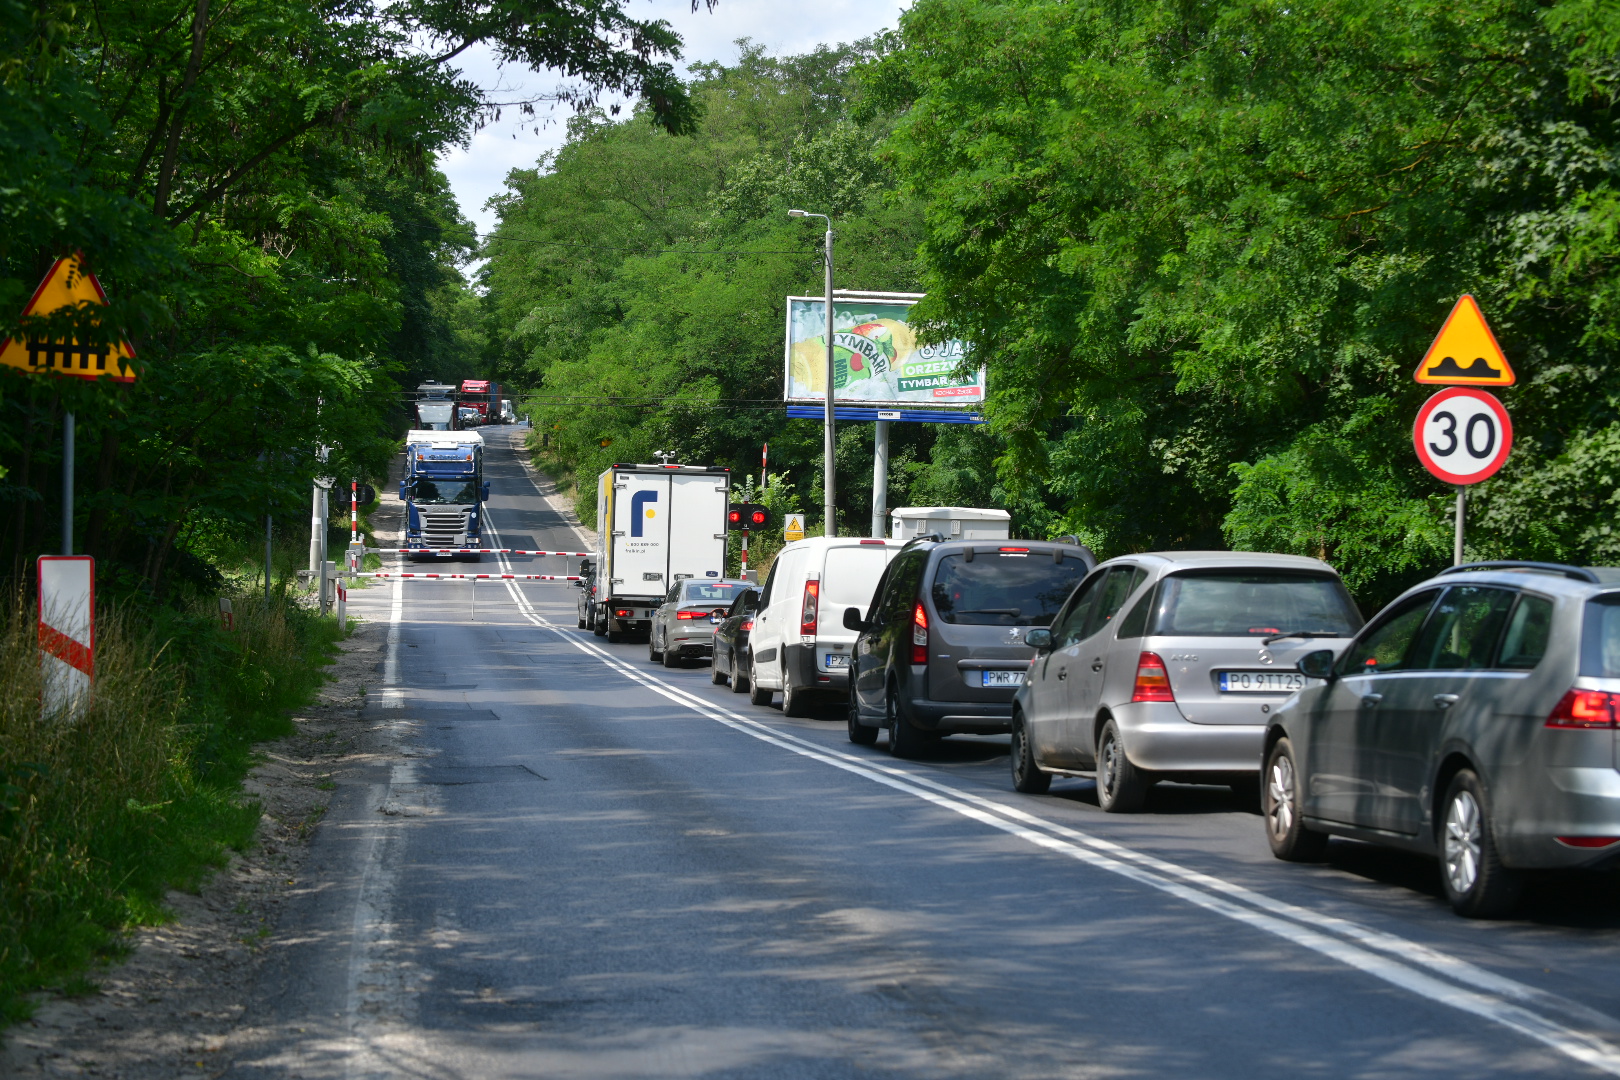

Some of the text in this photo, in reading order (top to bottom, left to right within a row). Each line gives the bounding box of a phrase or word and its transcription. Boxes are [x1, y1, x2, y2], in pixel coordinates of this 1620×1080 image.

[1429, 411, 1496, 459] 30
[989, 672, 1010, 683] PWR
[1230, 674, 1303, 690] PO 9TT25
